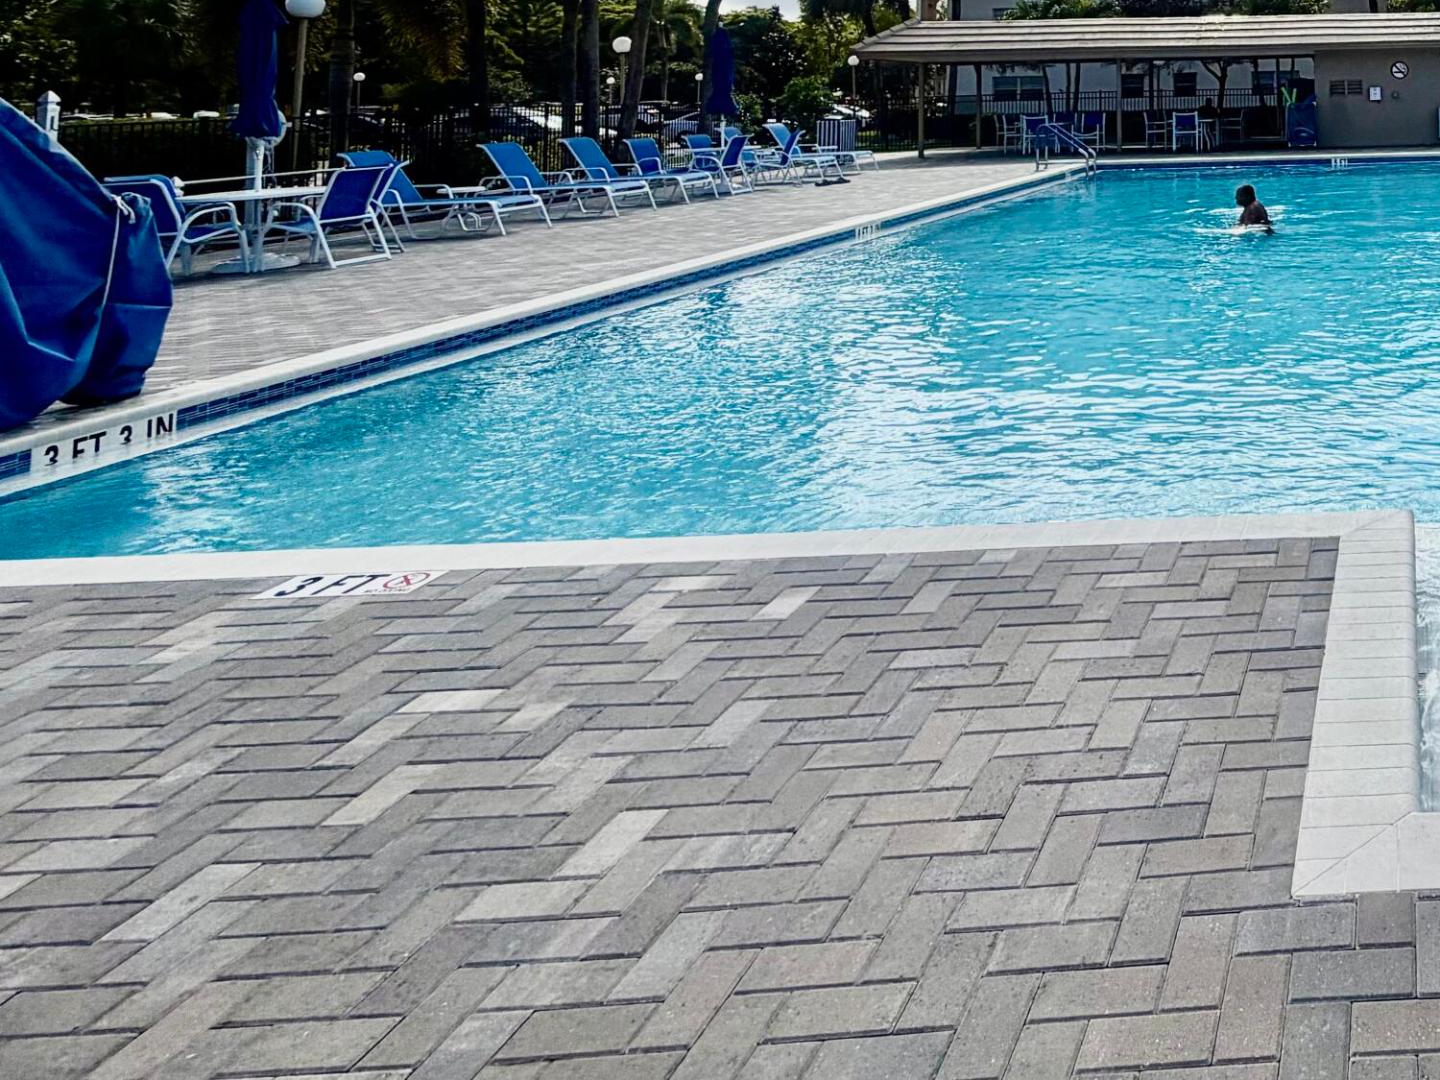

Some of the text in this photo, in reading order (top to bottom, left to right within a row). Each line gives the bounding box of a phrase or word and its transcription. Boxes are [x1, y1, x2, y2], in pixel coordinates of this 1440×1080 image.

[44, 413, 174, 466] 3 FT 3 IN
[274, 573, 392, 597] 3 FT
